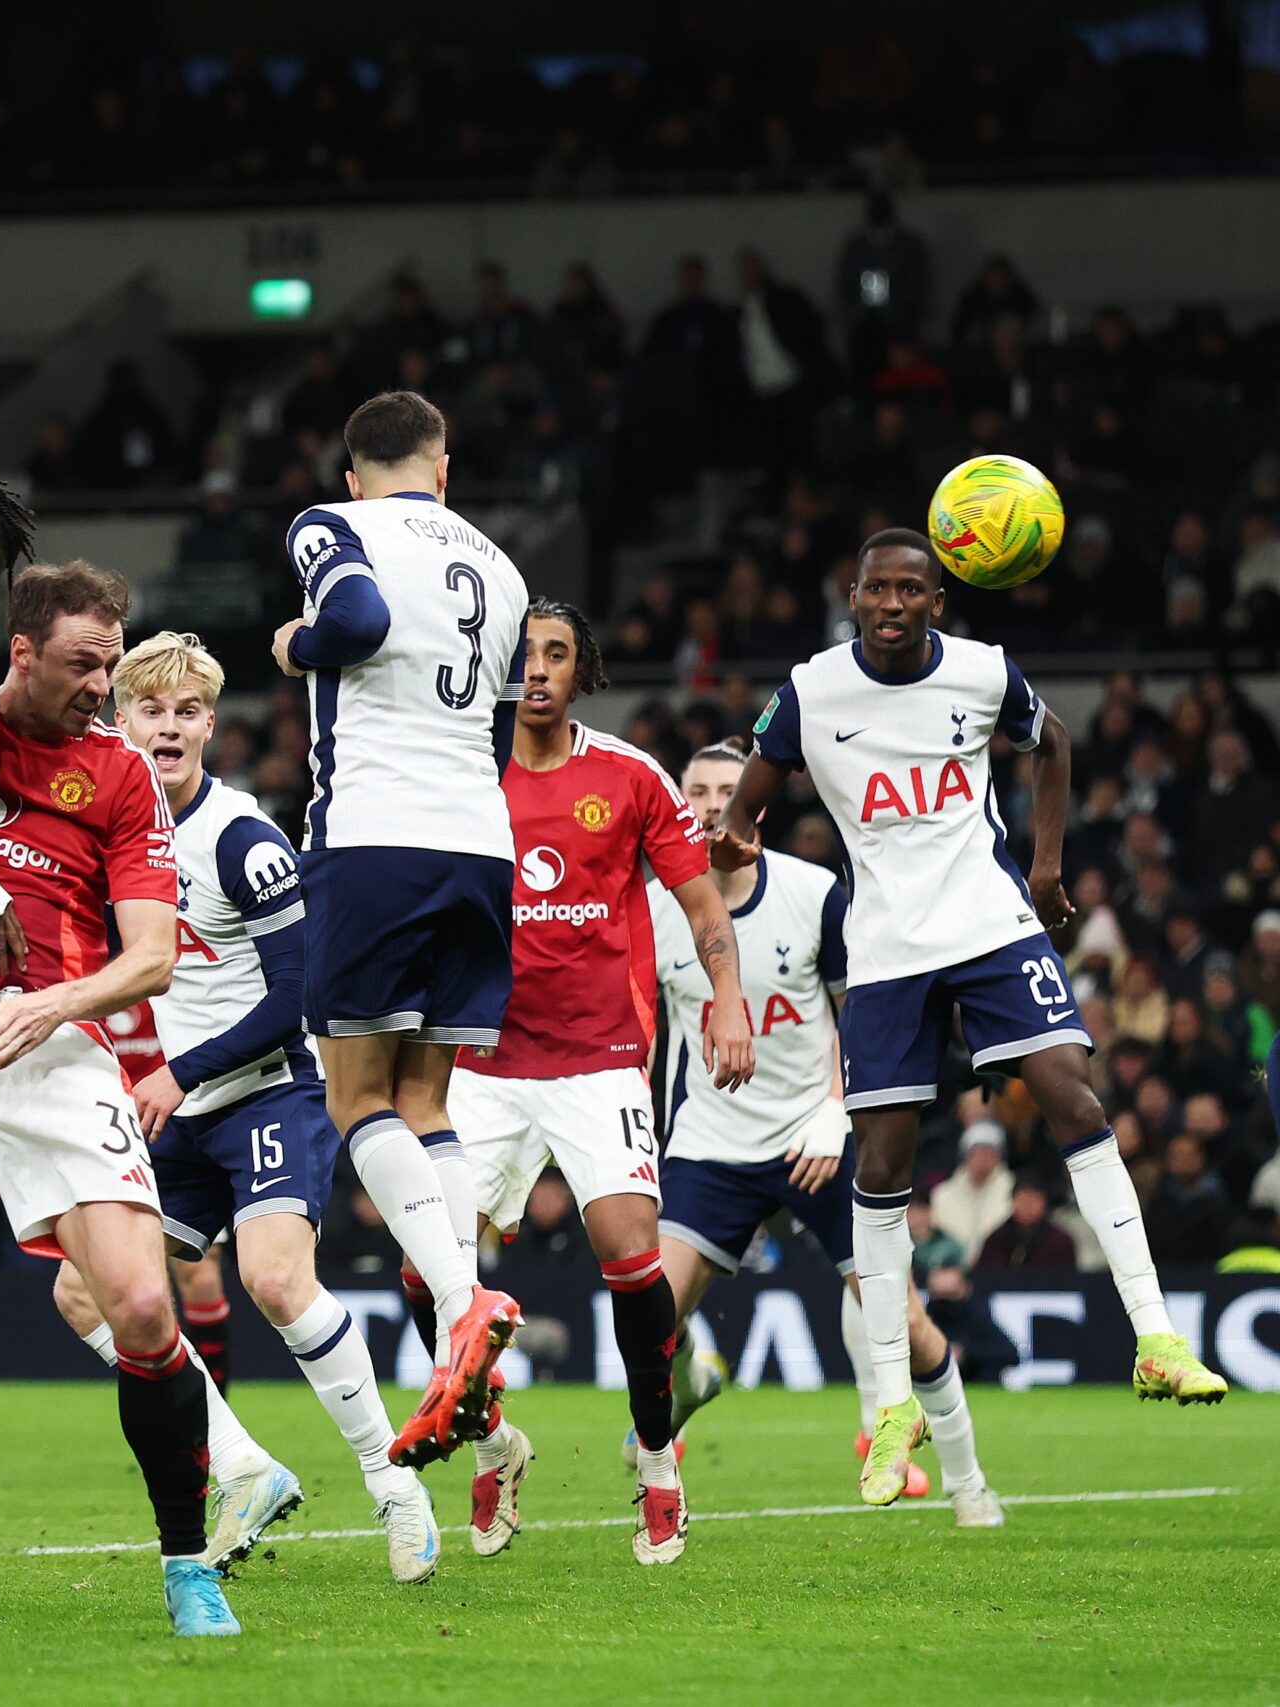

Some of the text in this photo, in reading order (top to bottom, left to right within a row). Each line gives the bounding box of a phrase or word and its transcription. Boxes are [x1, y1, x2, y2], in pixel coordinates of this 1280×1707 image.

[436, 561, 486, 710] 3
[860, 760, 974, 822] AIA
[1021, 956, 1067, 1006] 29
[251, 1122, 283, 1173] 15
[620, 1107, 653, 1156] 15
